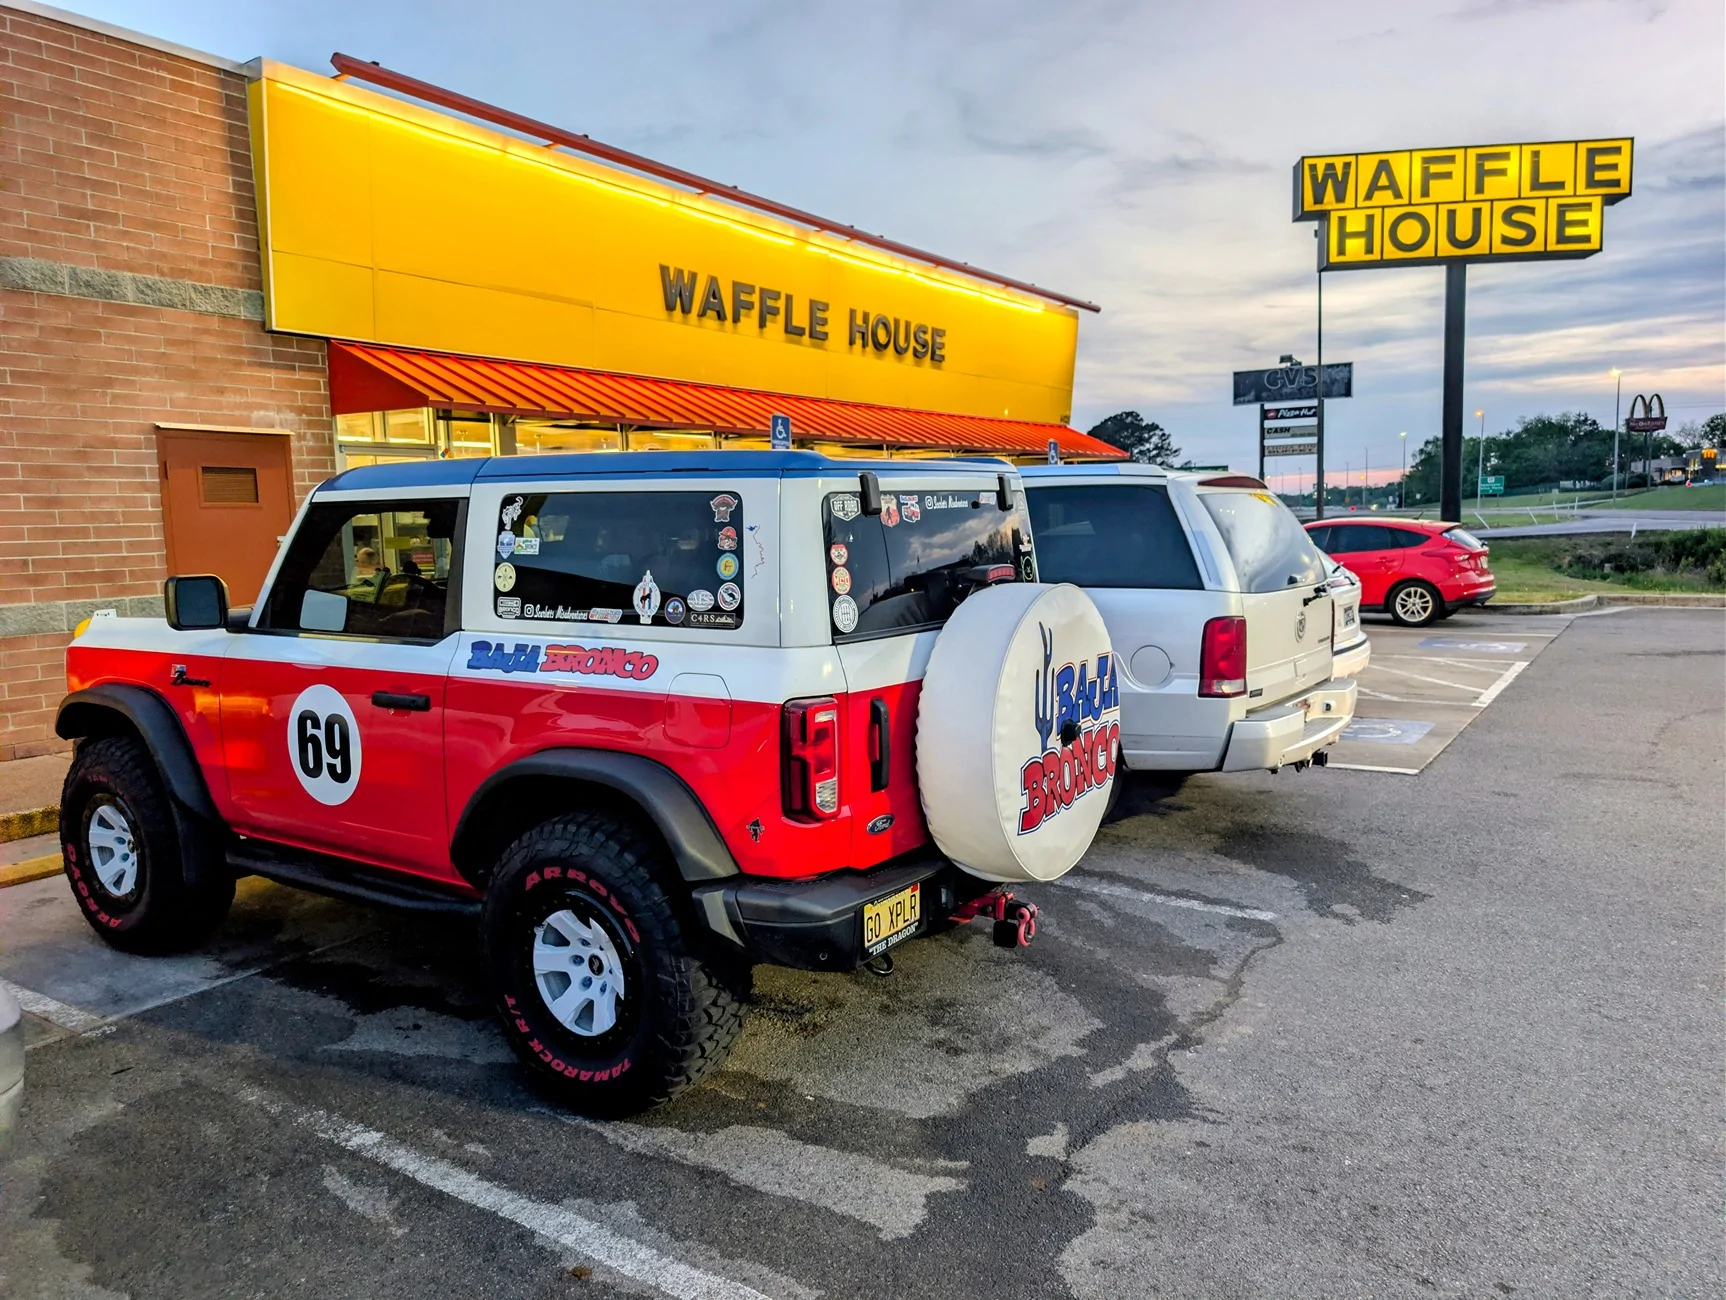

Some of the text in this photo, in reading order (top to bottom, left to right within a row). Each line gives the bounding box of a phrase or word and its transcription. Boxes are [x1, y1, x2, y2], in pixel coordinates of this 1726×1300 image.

[1308, 146, 1622, 206] WAFFLE
[1336, 202, 1593, 257] HOUSE
[658, 263, 946, 363] WAFFLE HOUSE
[1264, 367, 1318, 389] CVS
[1266, 426, 1290, 434] CASH
[1278, 408, 1316, 418] Pizza Hut
[691, 613, 715, 623] C4RS
[467, 640, 659, 680] BAJA BRONCO
[1055, 651, 1119, 741] BAJA
[297, 709, 352, 784] 69
[1017, 720, 1120, 836] BRONCO
[66, 843, 122, 927] ARROYO
[525, 866, 640, 943] ARROYO
[866, 912, 881, 943] GO
[889, 894, 917, 932] XPLR
[528, 1037, 631, 1082] TAMAROCK
